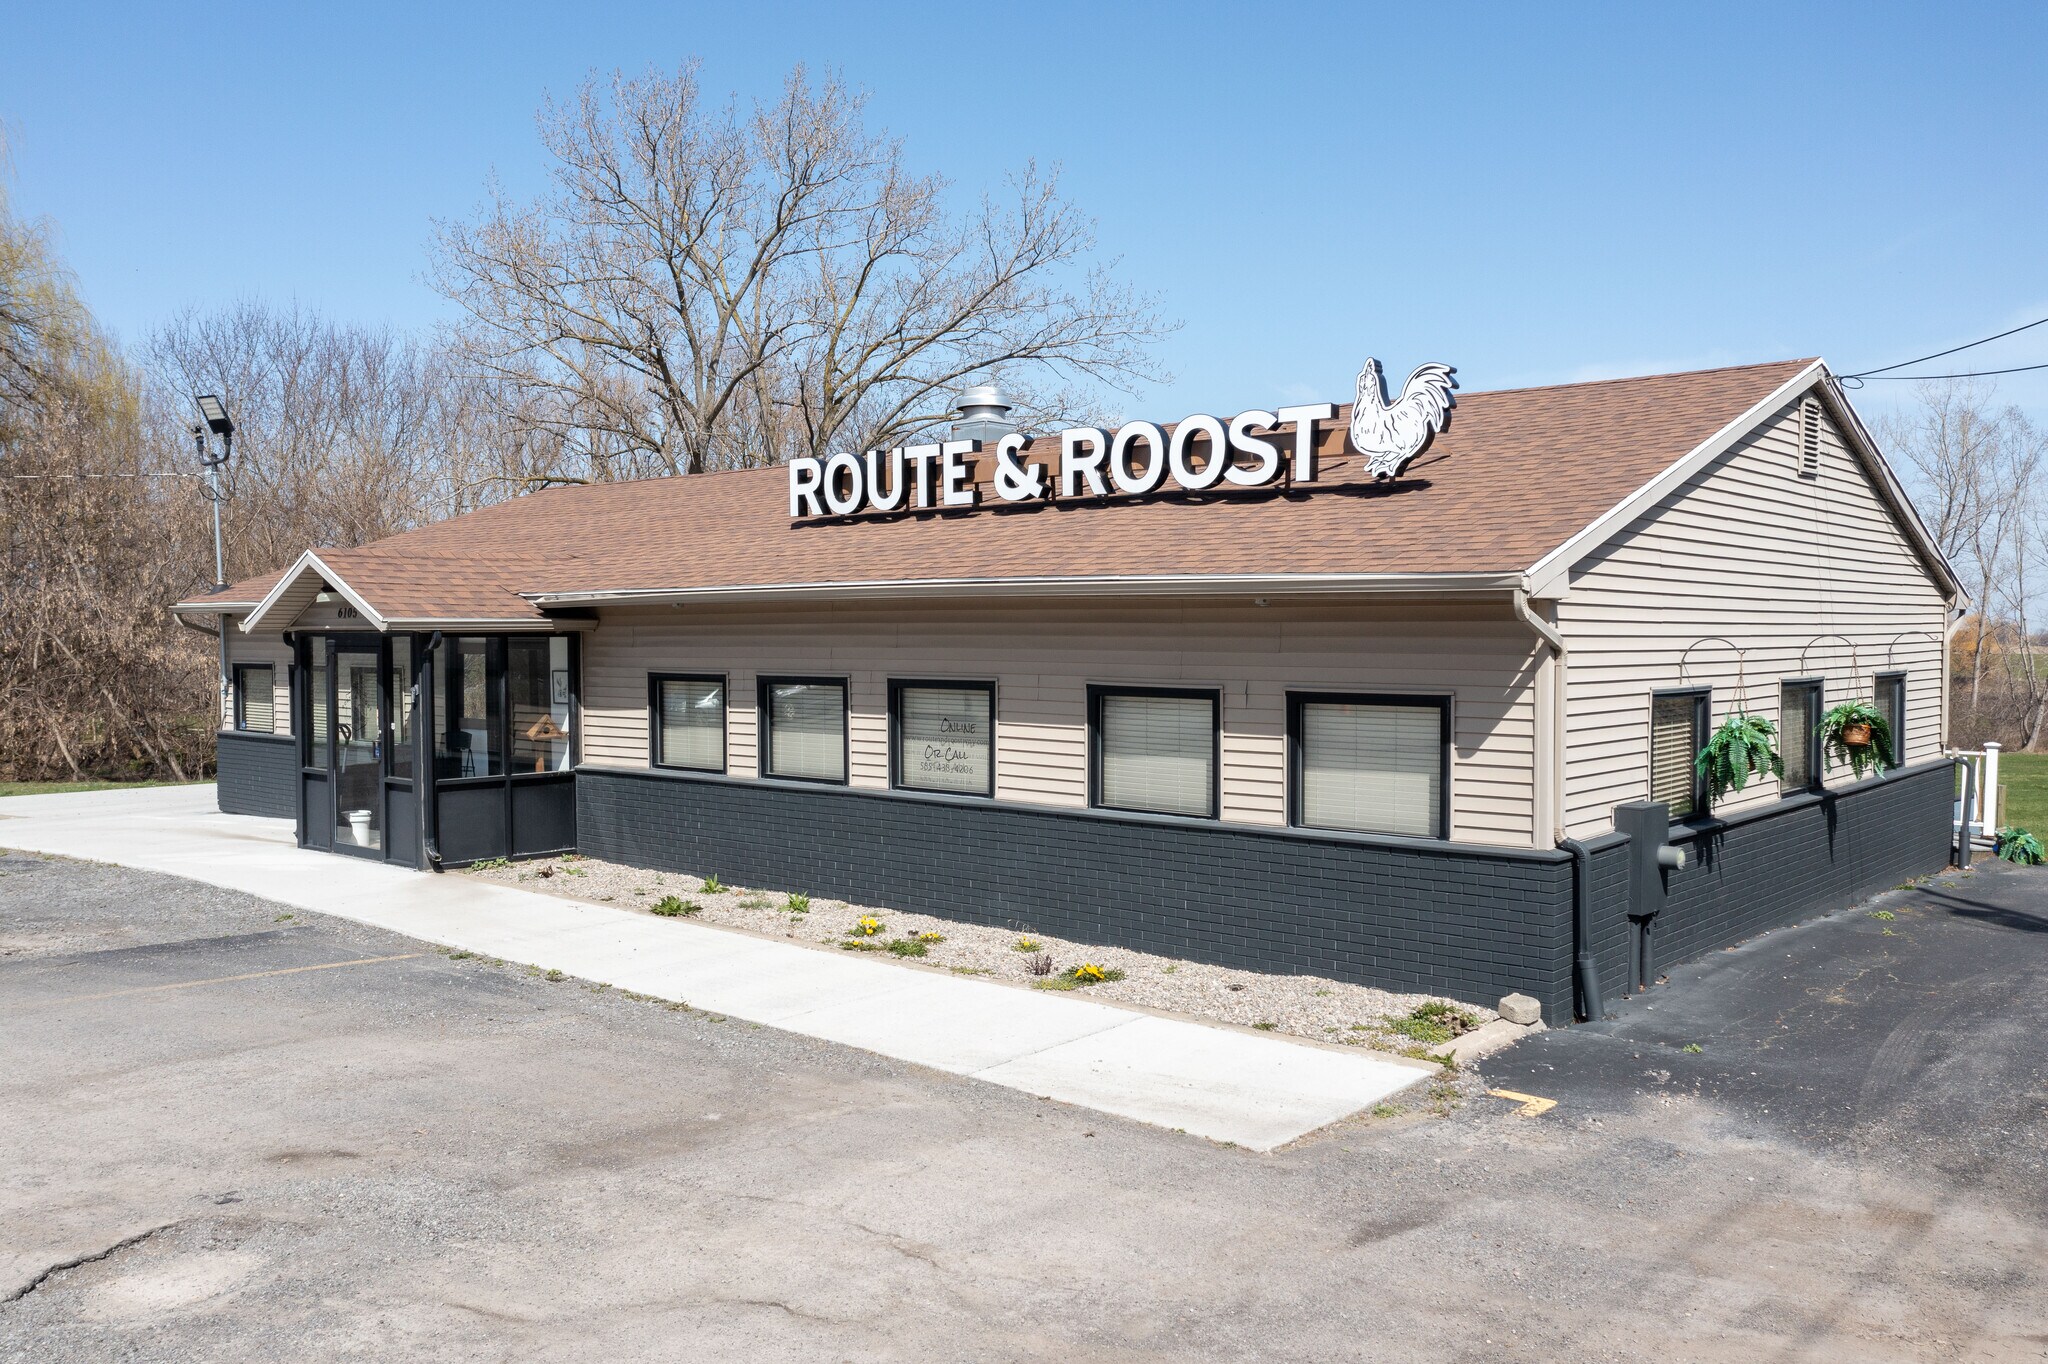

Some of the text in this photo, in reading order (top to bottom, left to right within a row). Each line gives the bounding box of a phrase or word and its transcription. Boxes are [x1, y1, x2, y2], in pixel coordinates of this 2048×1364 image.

[789, 402, 1339, 517] ROUTE & ROOST
[338, 607, 357, 619] 6105
